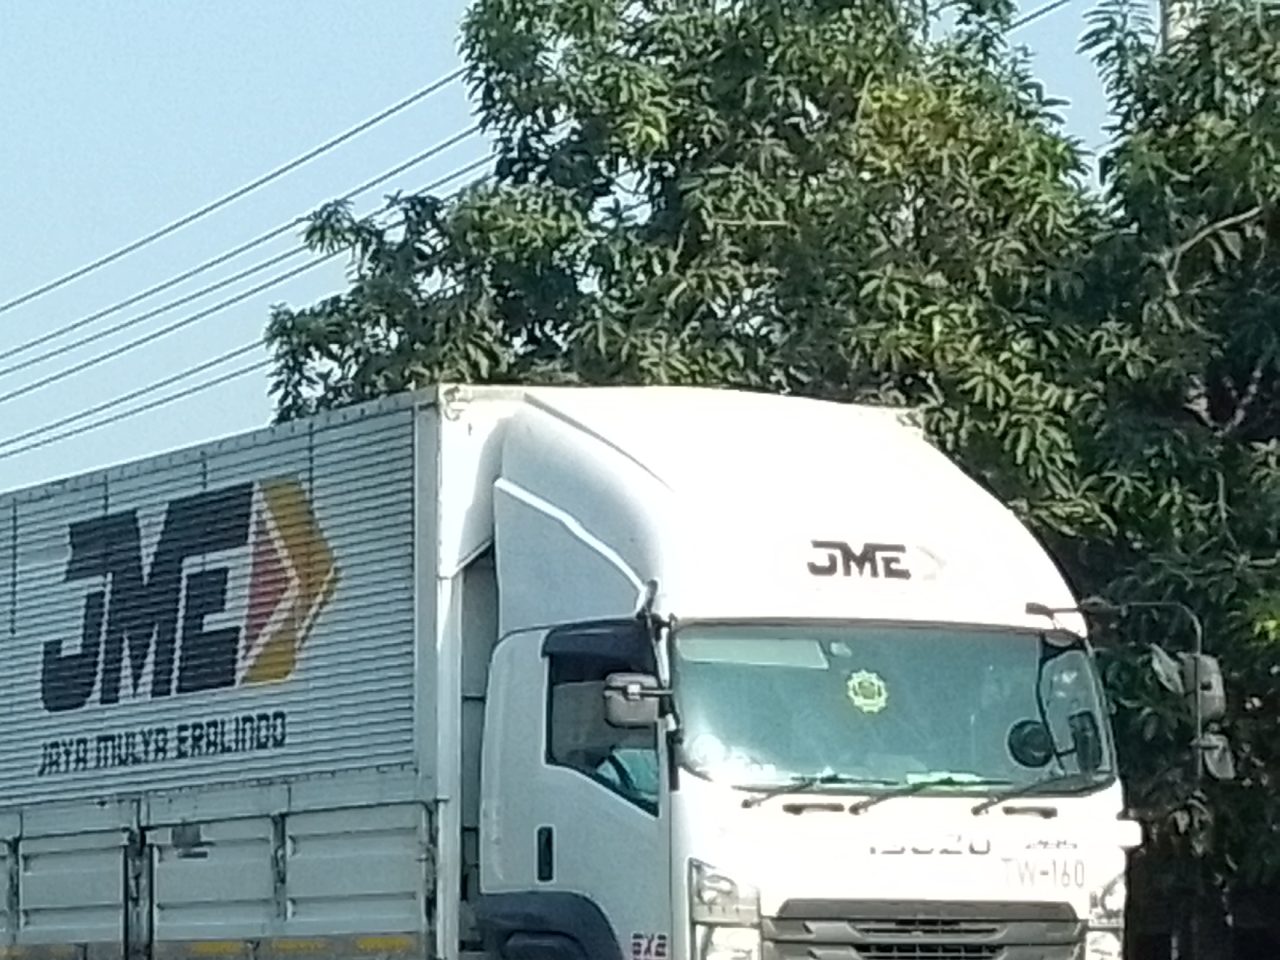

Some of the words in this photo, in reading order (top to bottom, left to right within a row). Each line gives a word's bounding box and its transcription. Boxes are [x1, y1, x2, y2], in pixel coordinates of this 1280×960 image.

[807, 540, 911, 580] JME
[42, 482, 255, 712] JME
[38, 736, 89, 777] JAYA
[95, 726, 170, 770] MULYA
[175, 710, 287, 760] ERALINDO
